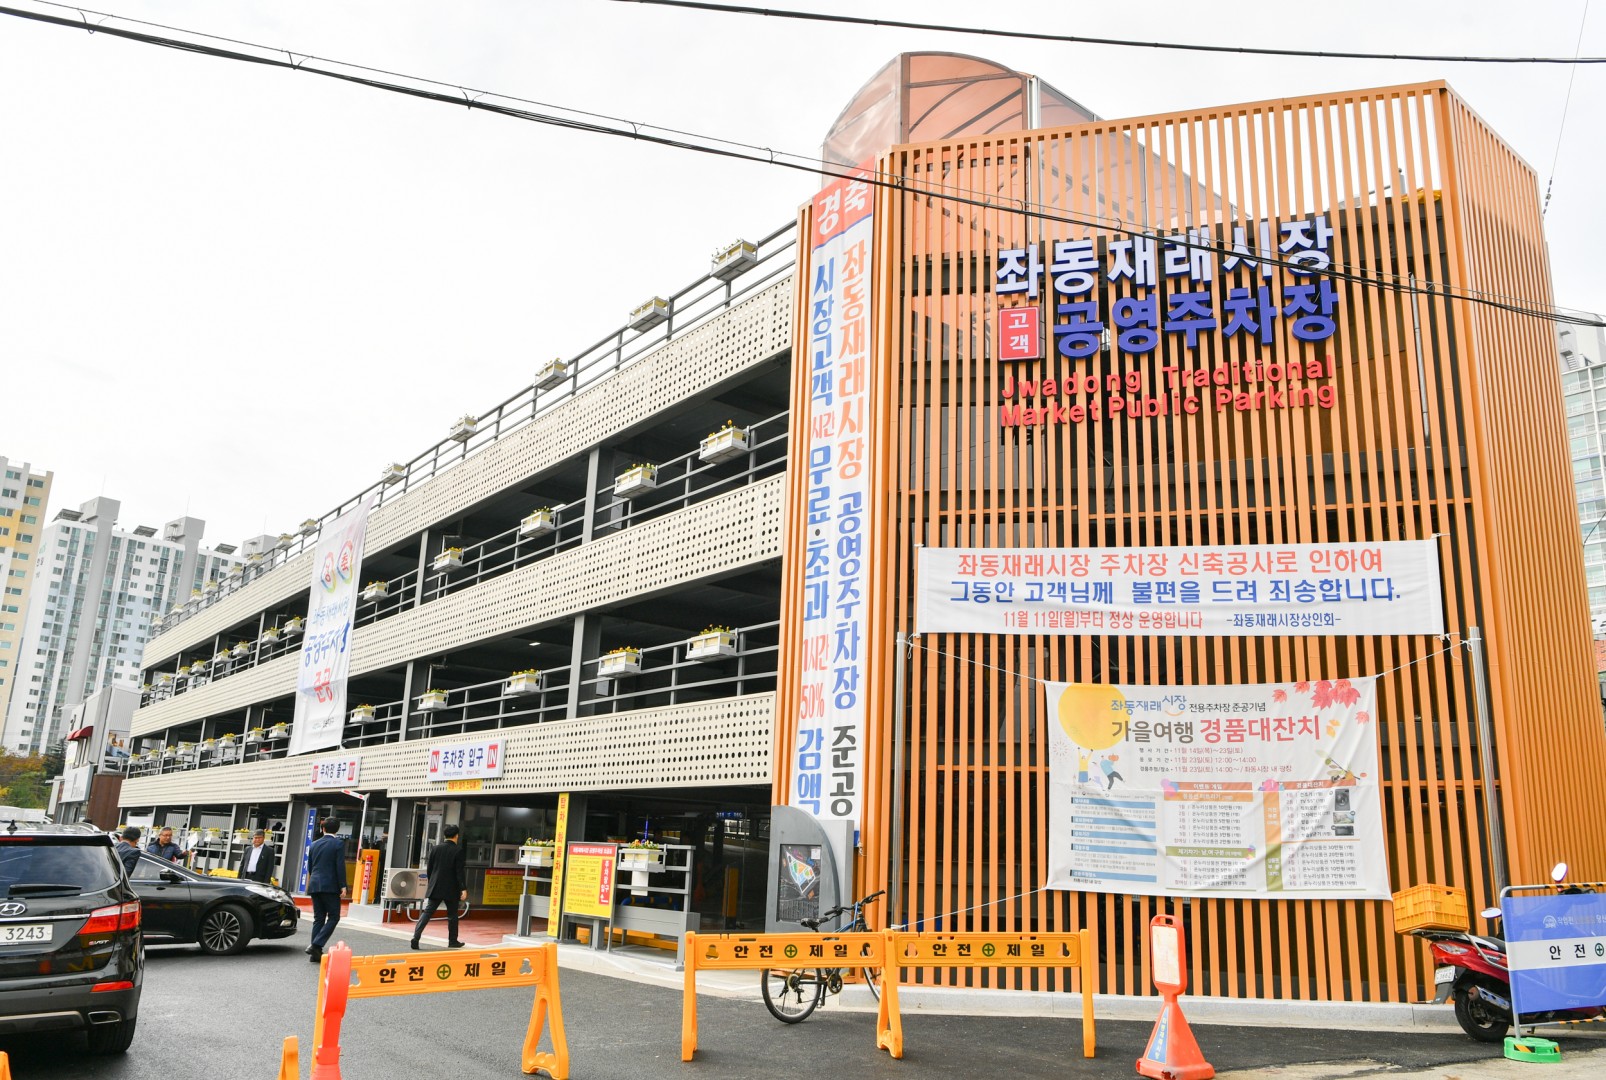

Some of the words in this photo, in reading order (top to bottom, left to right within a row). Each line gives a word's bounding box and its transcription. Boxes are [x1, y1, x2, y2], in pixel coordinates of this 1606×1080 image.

[995, 215, 1334, 298] 좌동재래시장
[812, 257, 834, 406] 시장고객
[1007, 313, 1030, 353] 고객
[1053, 279, 1339, 359] 공영주차장
[837, 239, 867, 480] 좌동재래시장
[1001, 370, 1142, 399] Jwadong
[1162, 355, 1334, 389] Traditional
[1000, 400, 1100, 427] Market
[1108, 391, 1199, 419] Public
[1216, 383, 1335, 412] Parking
[957, 553, 1090, 577] 좌동재래시장
[1100, 553, 1168, 577] 주차장
[1178, 551, 1298, 576] 신축공사로
[1309, 548, 1382, 573] 인하여
[833, 491, 862, 710] 공영주차장
[950, 581, 1015, 603] 그동안
[1024, 581, 1113, 604] 고객님께
[1131, 580, 1200, 604] 불편을
[1212, 580, 1257, 603] 드려
[1269, 577, 1401, 603] 죄송합니다.
[1003, 610, 1028, 628] 11월
[1109, 611, 1133, 629] 정상
[1139, 610, 1202, 629] 운영합니다
[800, 682, 825, 720] 50%
[1111, 695, 1187, 715] 좌동재래시장
[1189, 703, 1230, 713] 전용주차장
[1232, 702, 1266, 712] 준공기념
[1111, 720, 1194, 744] 가을여행
[1199, 715, 1320, 743] 경품대잔치
[320, 764, 335, 778] 주차장
[443, 749, 465, 769] 주차장
[469, 748, 484, 767] 입구
[797, 728, 824, 816] 감액
[830, 725, 857, 817] 준공
[6, 926, 45, 940] 3243
